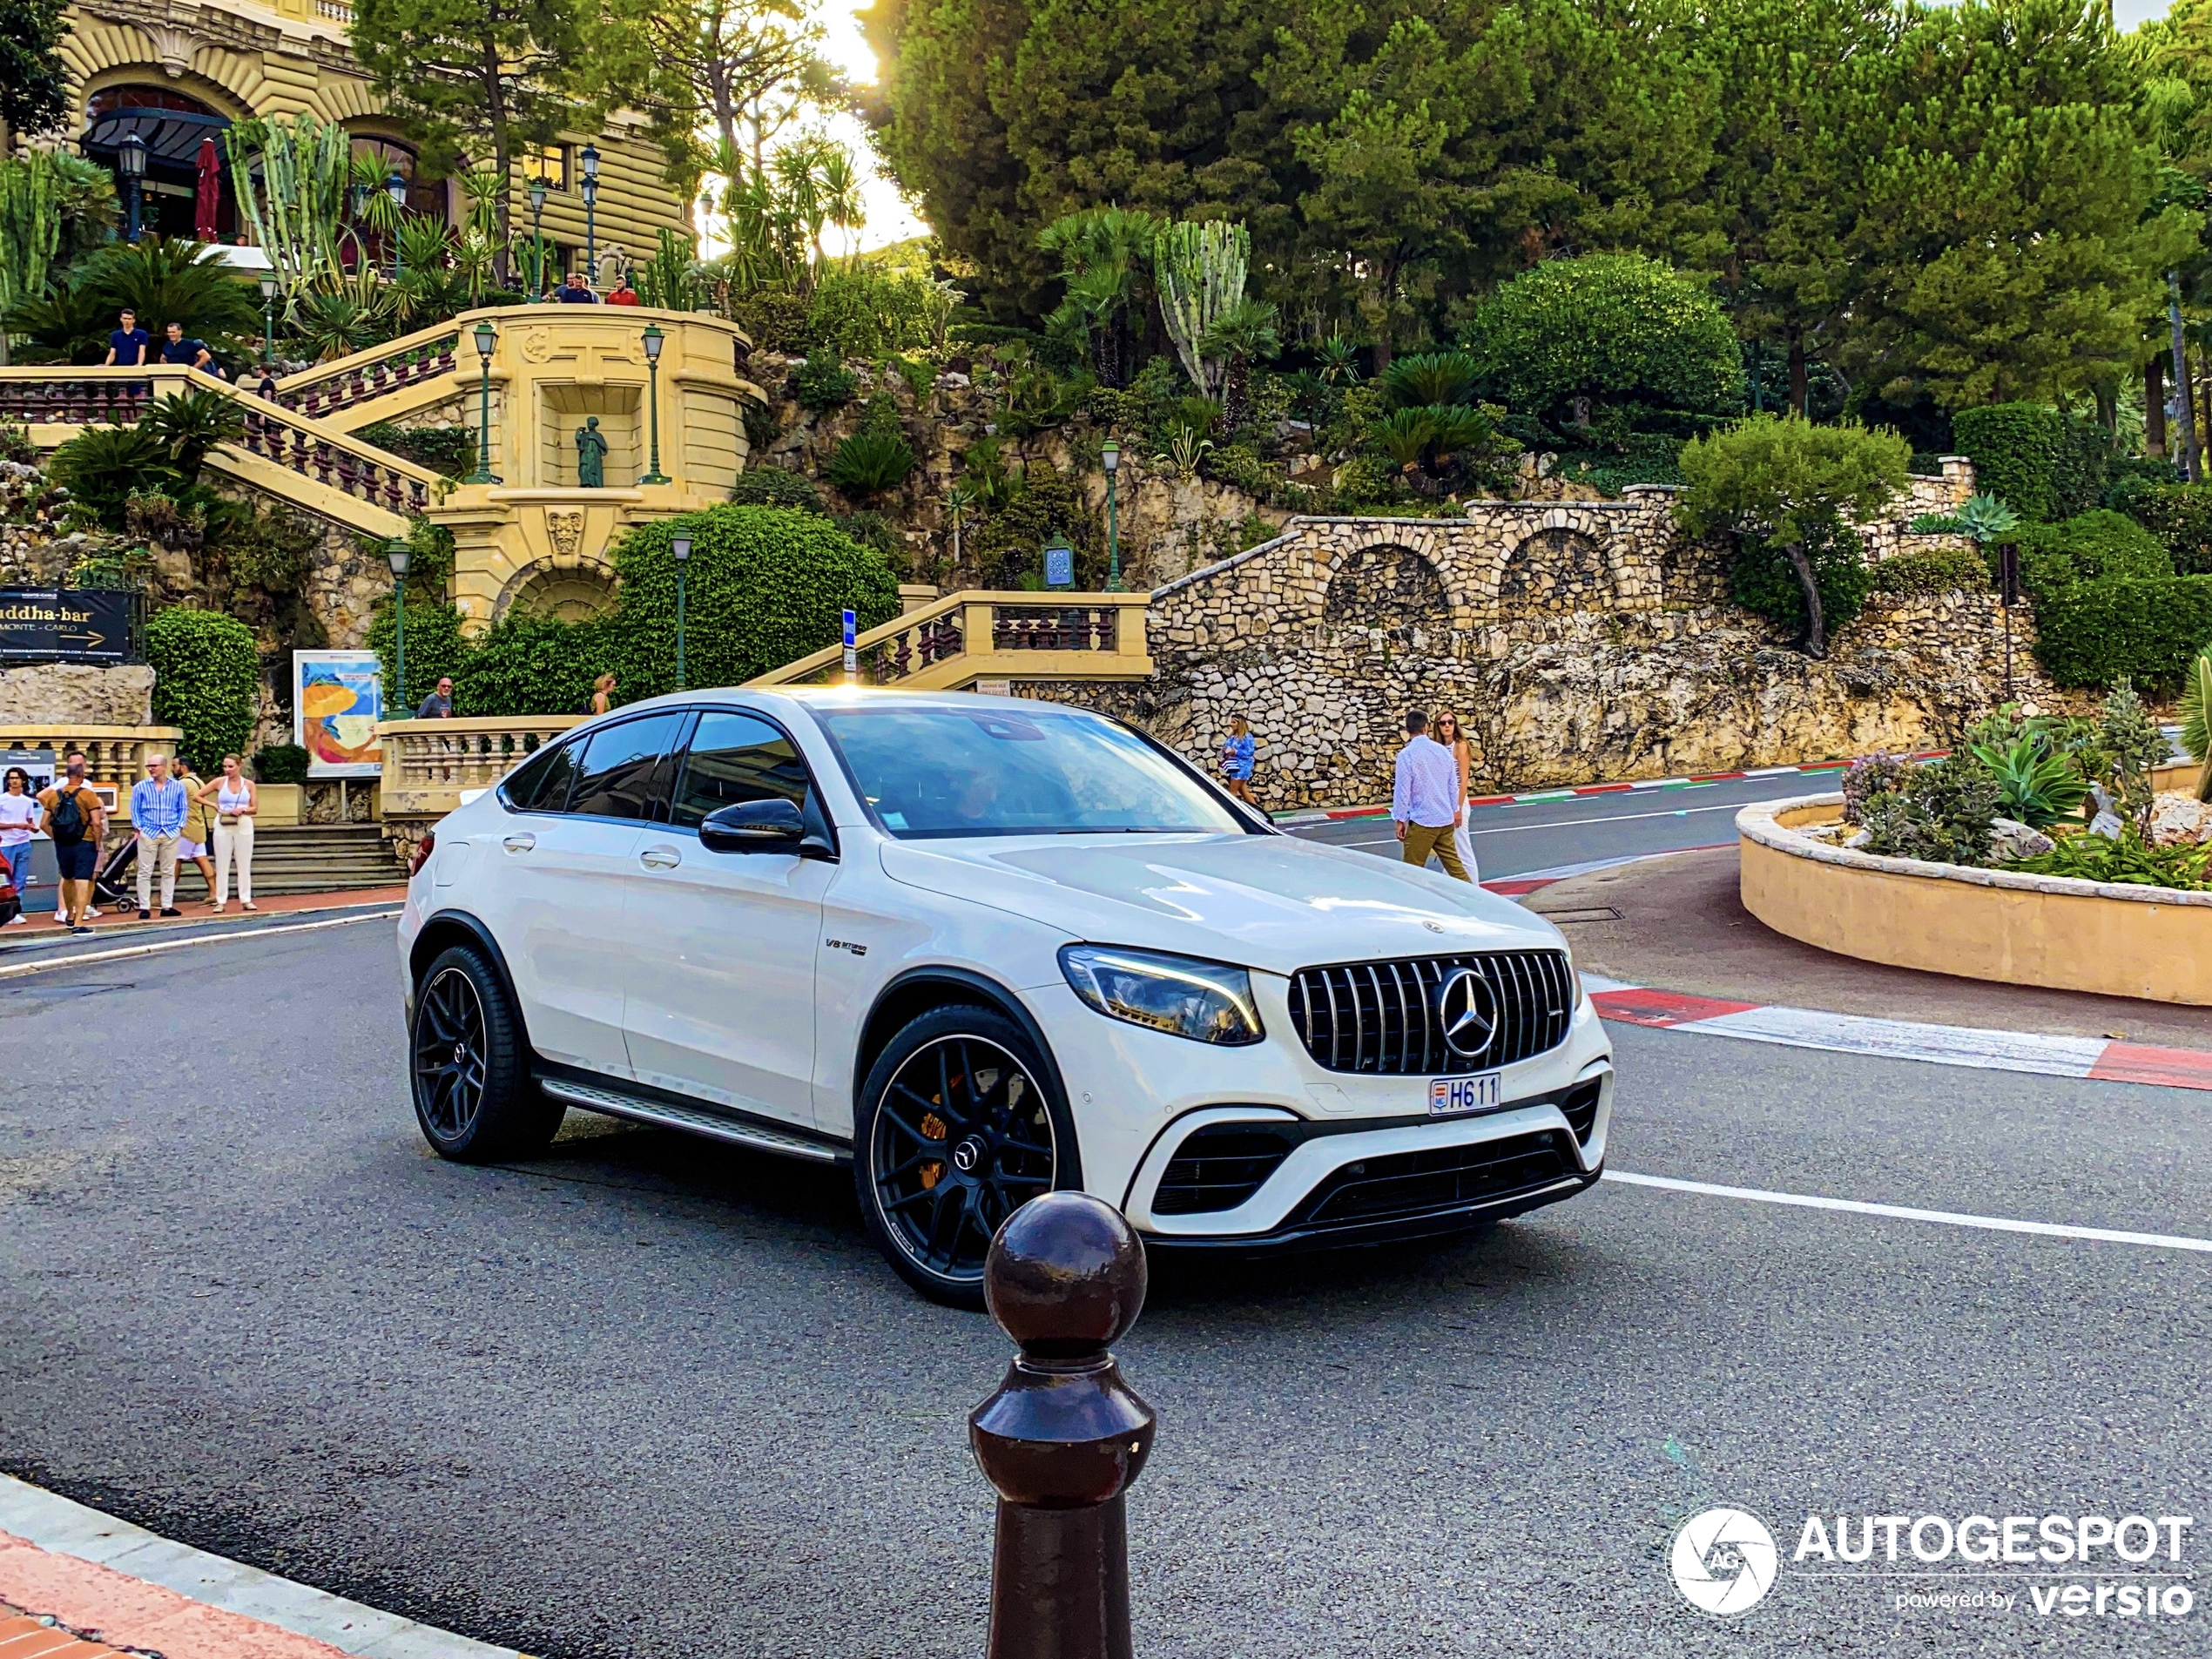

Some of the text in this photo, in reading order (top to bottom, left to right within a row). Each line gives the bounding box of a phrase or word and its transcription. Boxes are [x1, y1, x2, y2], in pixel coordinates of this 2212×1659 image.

[44, 624, 78, 632] CARLO
[826, 939, 841, 948] V8
[1451, 1078, 1495, 1108] H611
